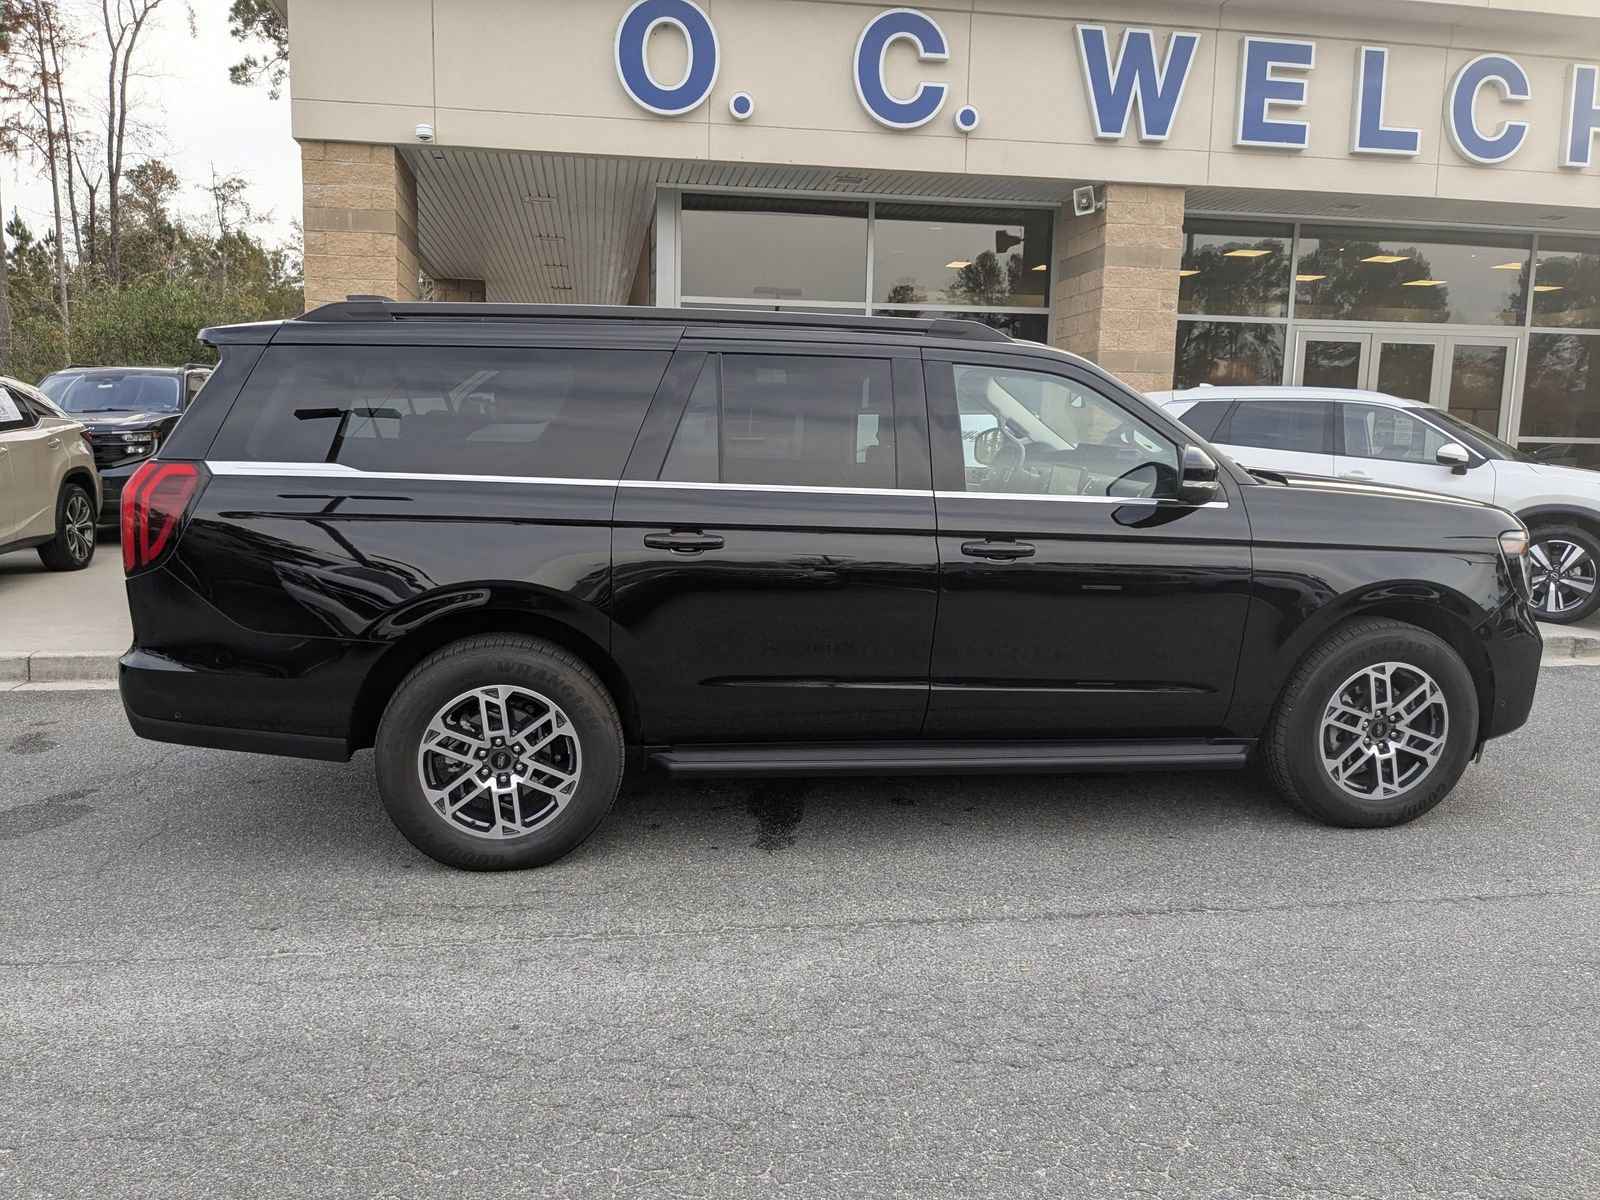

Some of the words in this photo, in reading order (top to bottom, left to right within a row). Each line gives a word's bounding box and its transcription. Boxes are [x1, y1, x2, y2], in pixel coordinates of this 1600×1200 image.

[614, 0, 754, 120] O.
[853, 7, 980, 132] C.
[496, 661, 603, 729] WRANGLER
